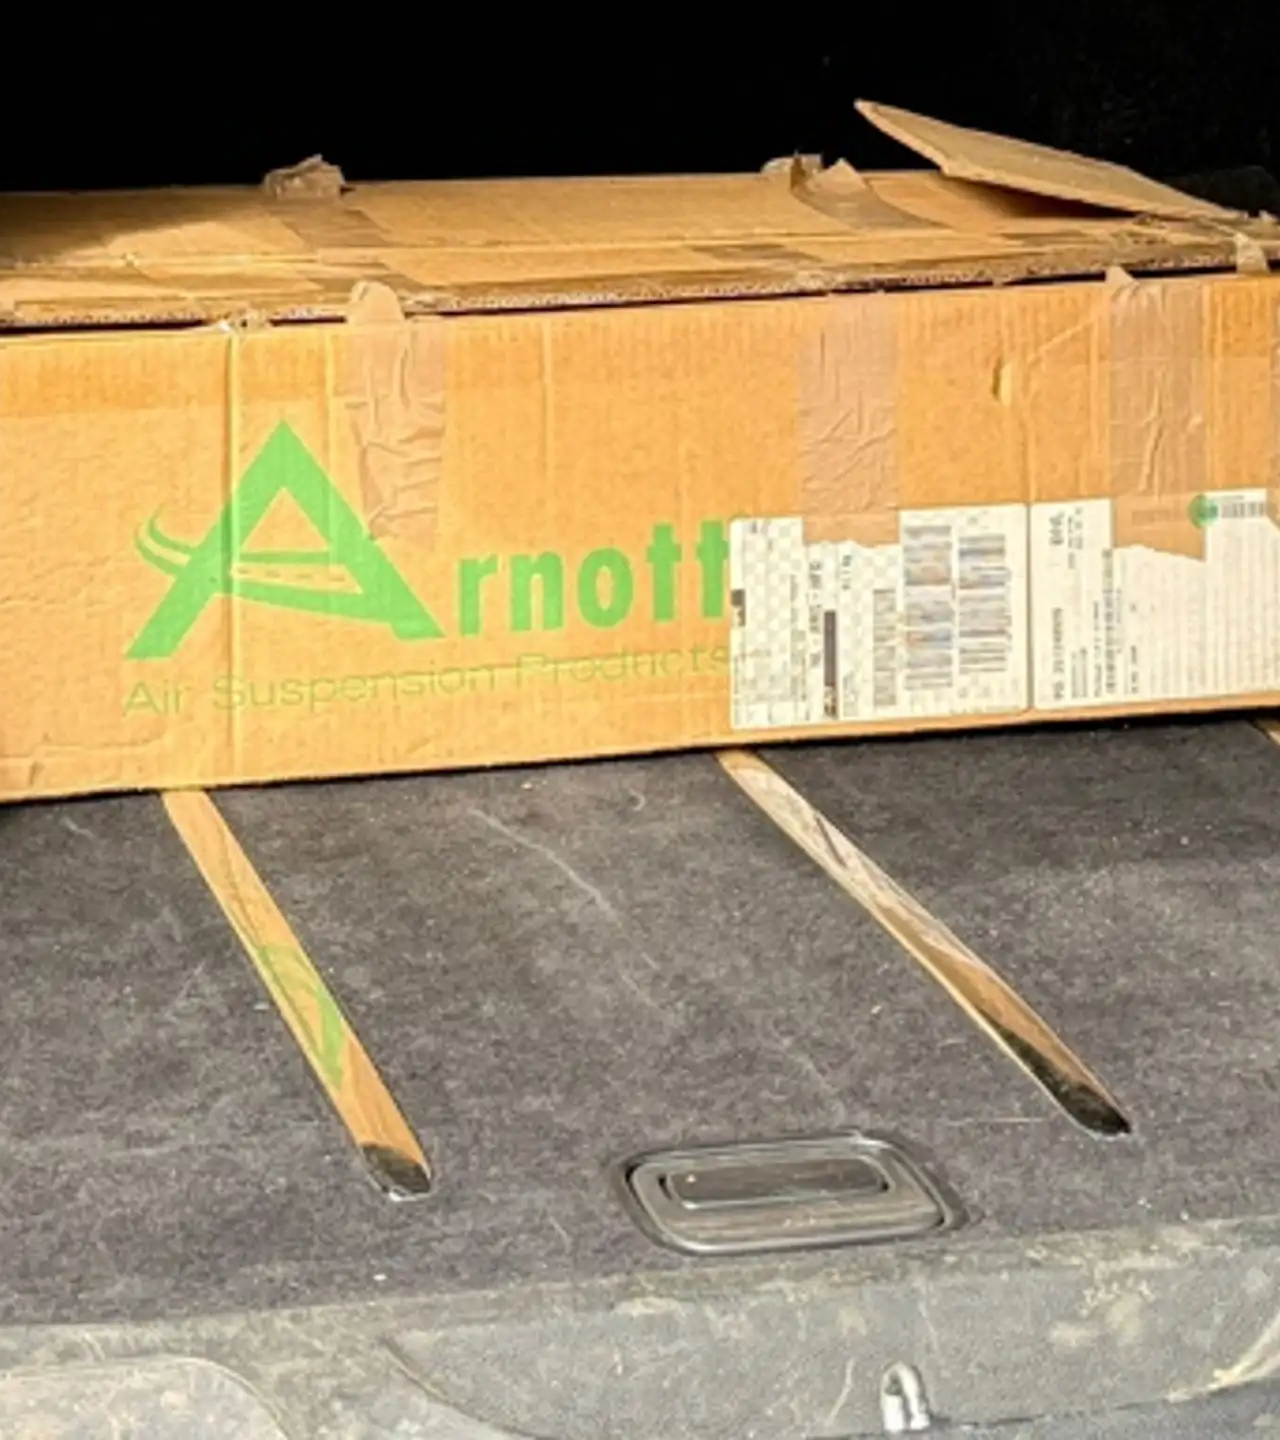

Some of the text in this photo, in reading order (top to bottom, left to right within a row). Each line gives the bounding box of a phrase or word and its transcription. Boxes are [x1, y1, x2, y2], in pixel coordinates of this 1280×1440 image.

[125, 420, 729, 659] Arnott
[124, 678, 186, 718] Air
[213, 658, 495, 712] Suspension
[517, 645, 730, 686] Products
